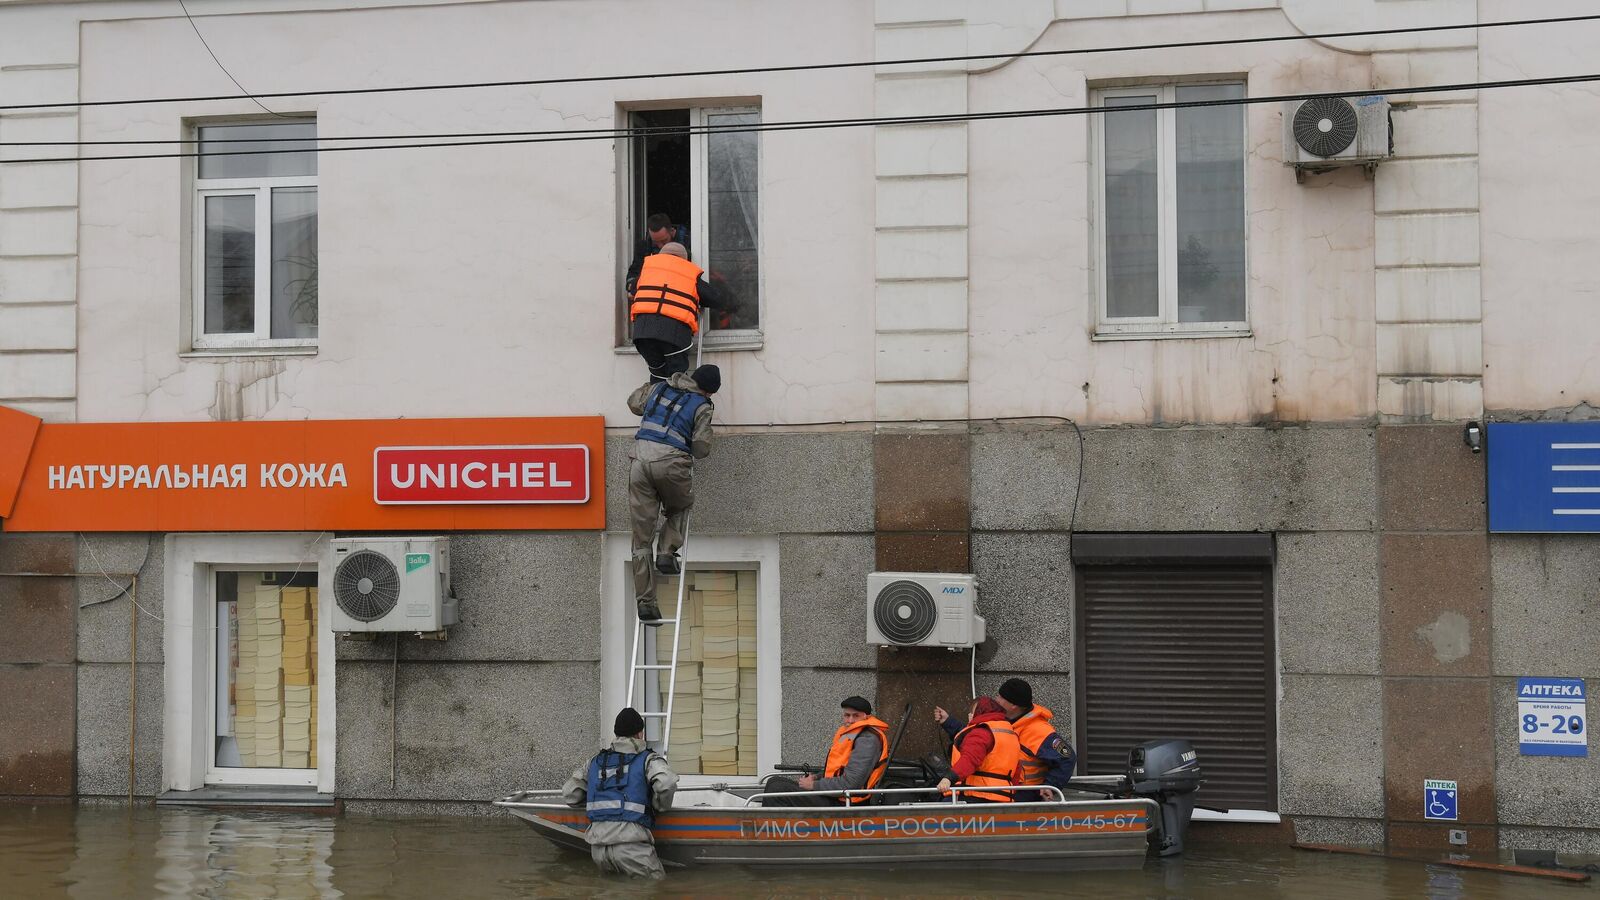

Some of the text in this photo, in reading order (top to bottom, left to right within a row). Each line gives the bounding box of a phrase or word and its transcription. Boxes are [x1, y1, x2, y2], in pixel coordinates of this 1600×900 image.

[48, 463, 348, 490] НАТУРАЛЬНАЯ КОЖА
[390, 461, 572, 489] UNICHEL
[1522, 684, 1582, 696] АПТЕКА
[1523, 714, 1583, 735] 8-20
[1425, 781, 1456, 789] АПТЕКА
[740, 821, 811, 838] ГИМС
[819, 819, 876, 837] МЧС
[884, 816, 996, 836] РОССИИ
[1037, 813, 1138, 831] 210-45-67
